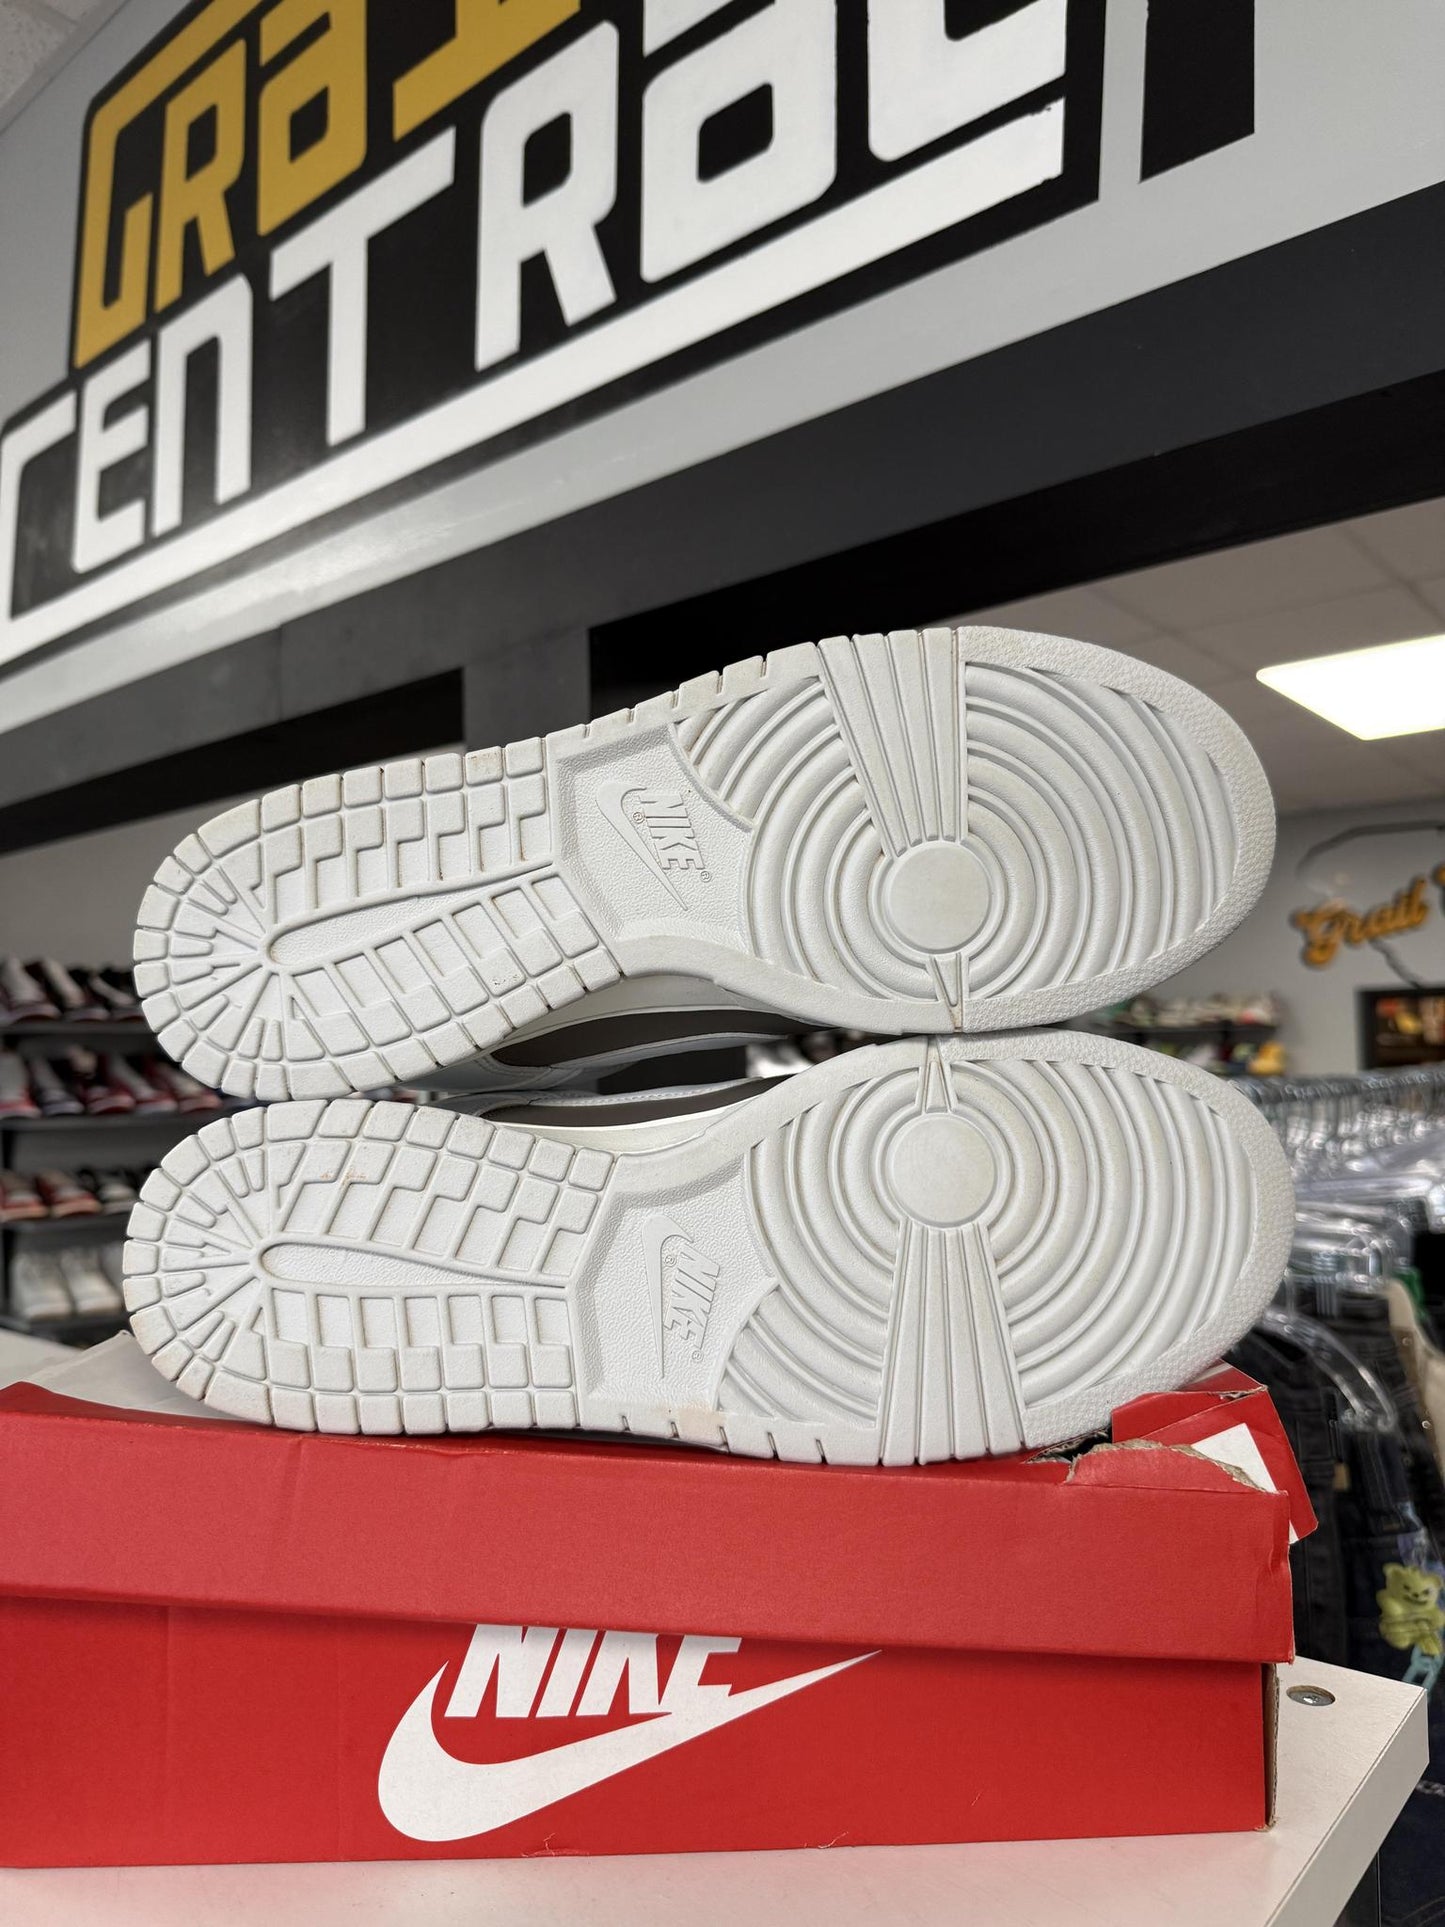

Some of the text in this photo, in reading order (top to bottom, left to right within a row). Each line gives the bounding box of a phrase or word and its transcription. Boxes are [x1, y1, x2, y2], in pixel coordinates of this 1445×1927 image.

[636, 791, 706, 871] NIKE
[663, 1242, 720, 1350] NIKE
[444, 1623, 743, 1718] NIKE
